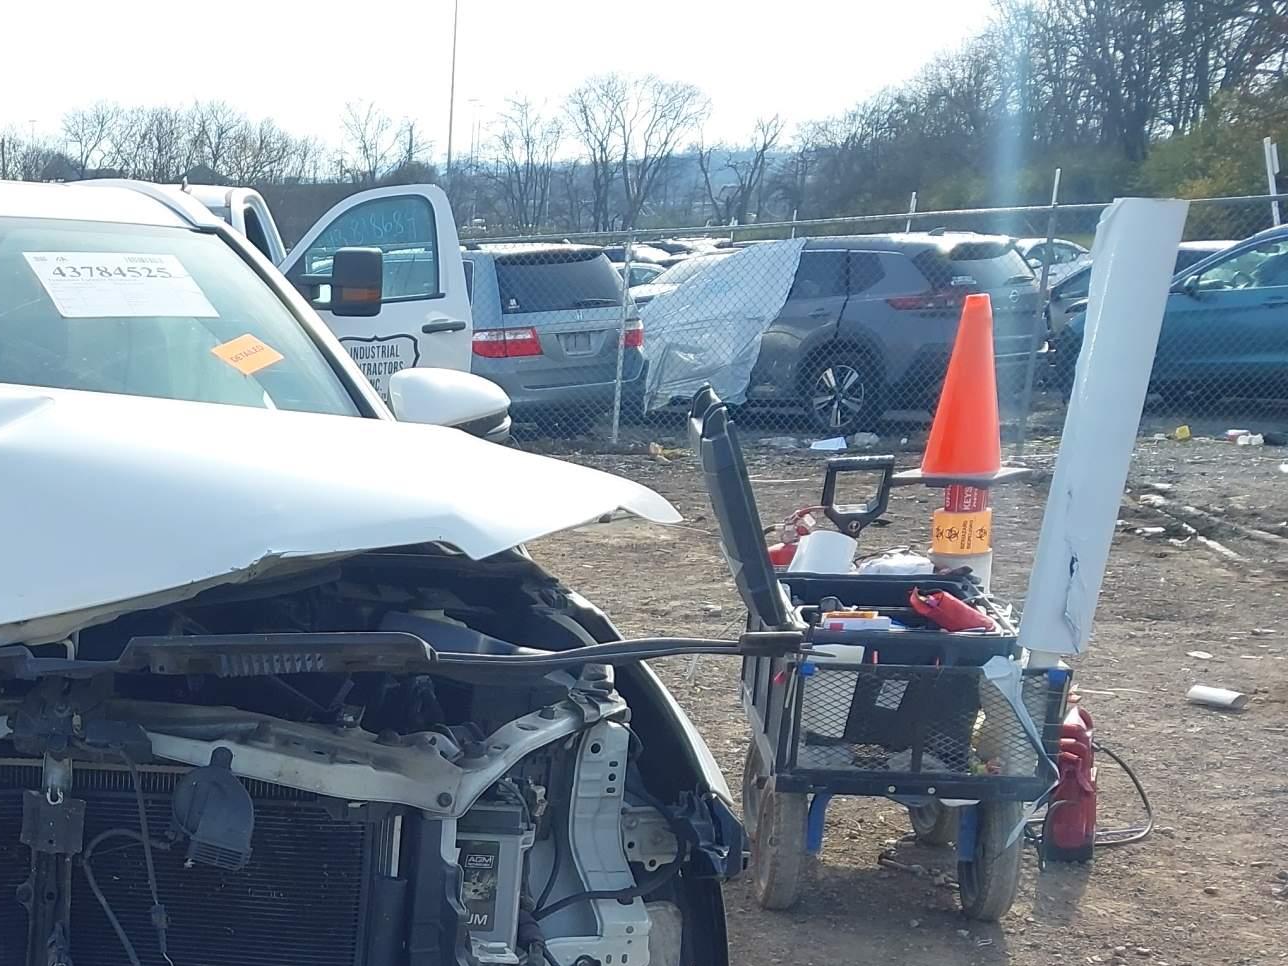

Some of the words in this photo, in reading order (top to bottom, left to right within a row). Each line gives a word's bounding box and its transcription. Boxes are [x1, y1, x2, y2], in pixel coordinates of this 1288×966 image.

[52, 265, 173, 279] 43784525
[350, 344, 400, 361] INDUSTRIAL
[359, 360, 404, 376] TRACTORS
[370, 378, 383, 391] NC.
